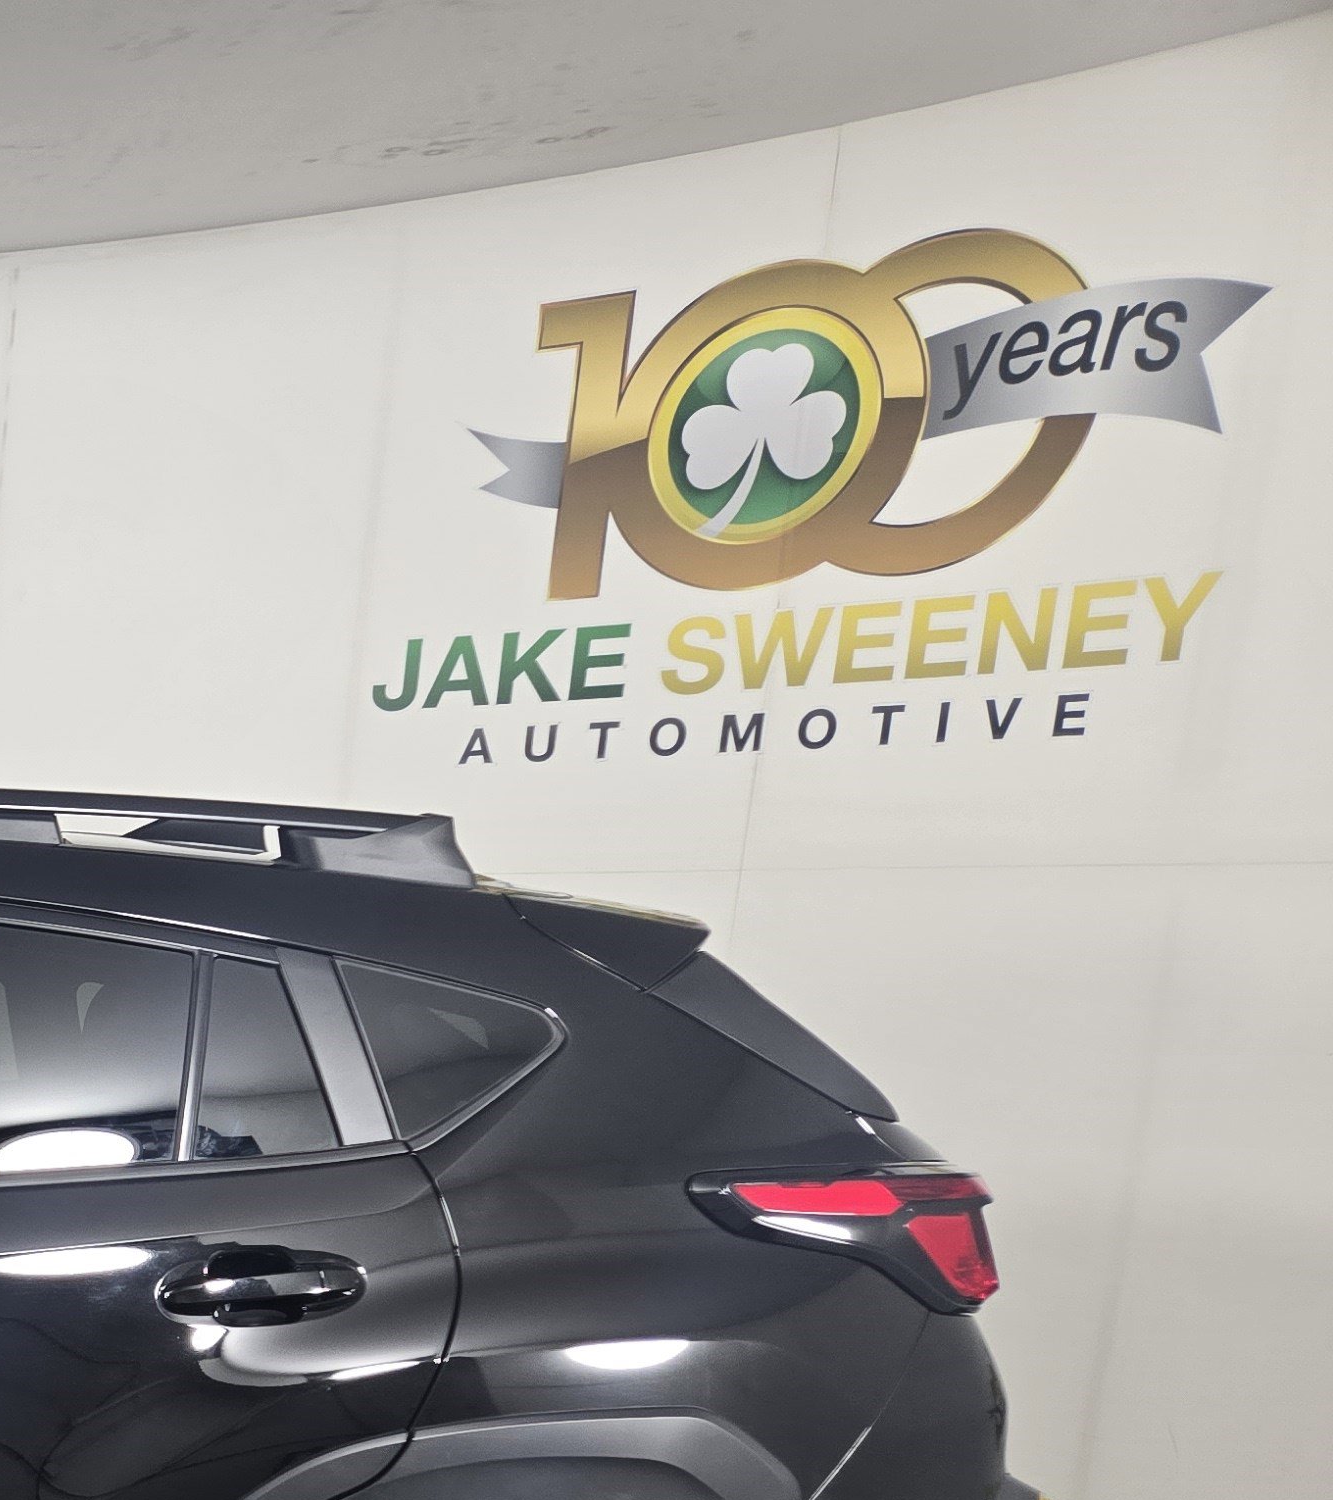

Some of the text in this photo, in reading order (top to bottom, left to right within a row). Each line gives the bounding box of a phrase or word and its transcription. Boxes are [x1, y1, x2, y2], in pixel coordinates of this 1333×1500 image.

[538, 228, 1096, 600] 100
[942, 295, 1188, 421] years
[372, 571, 1224, 712] JAKE SWEENEY
[459, 692, 1092, 766] AUTOMOTIVE
